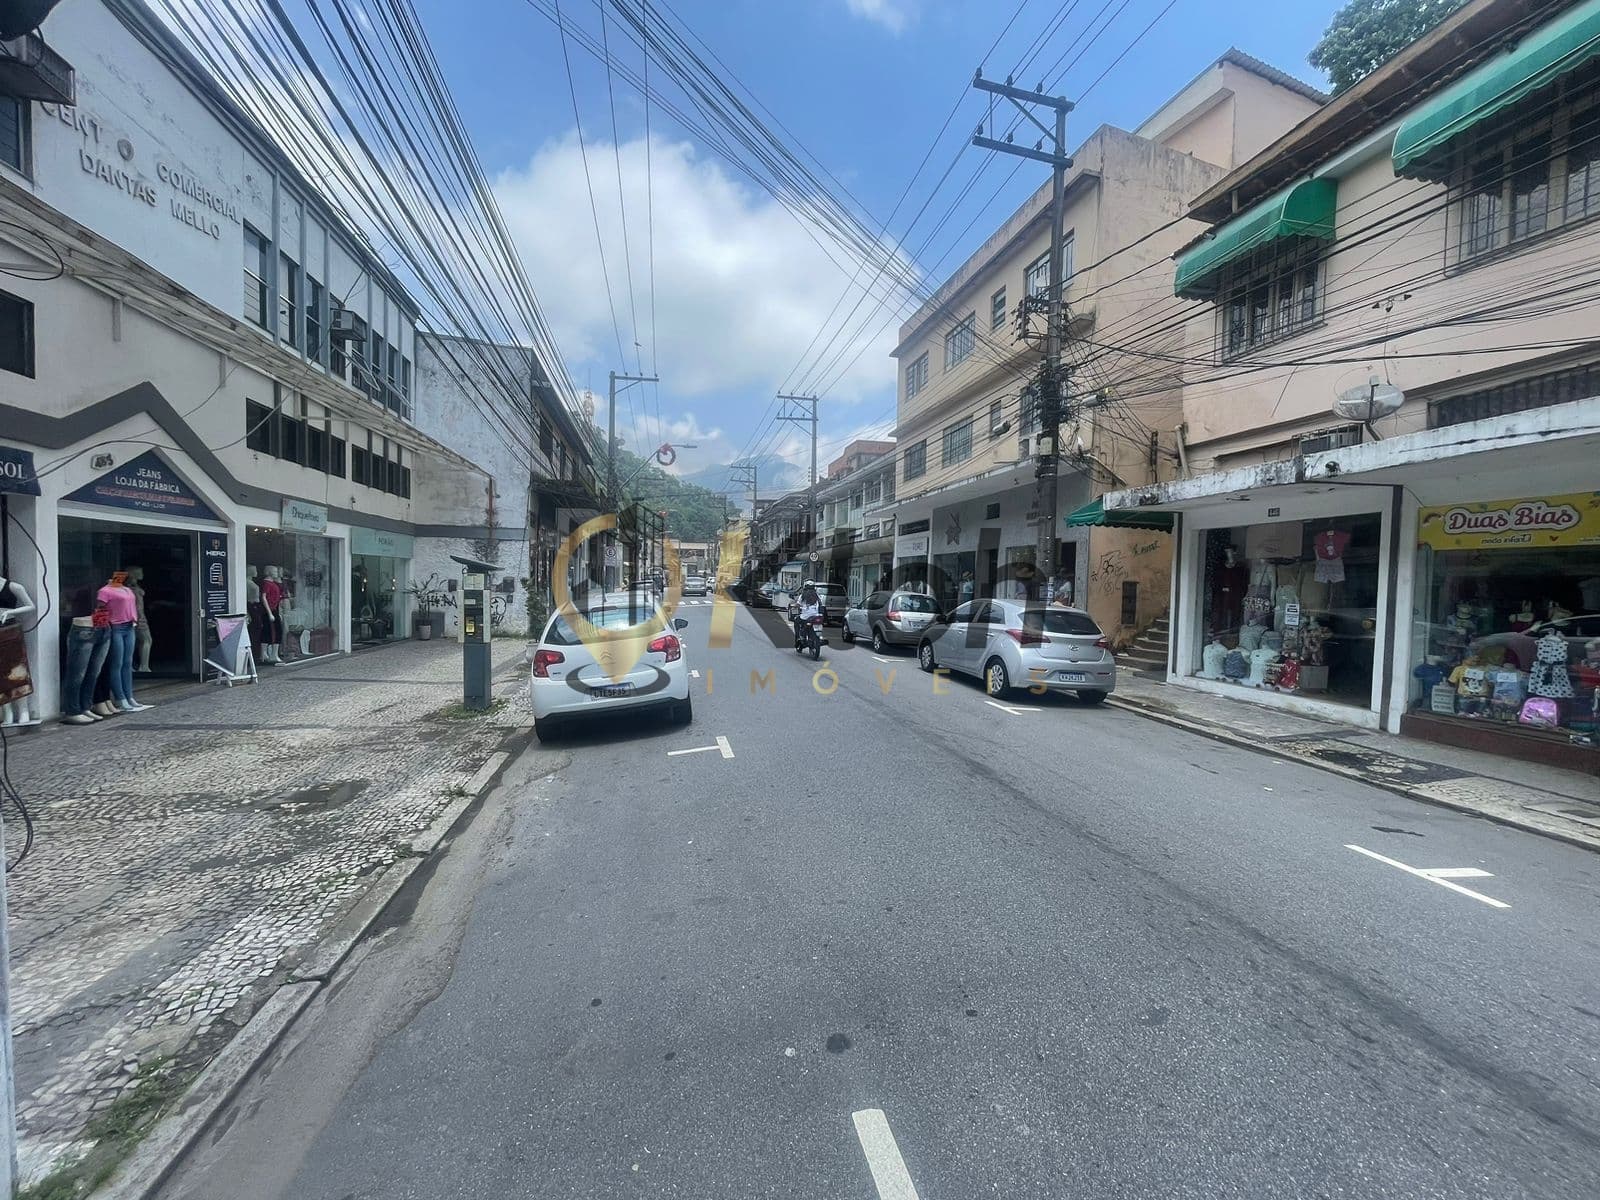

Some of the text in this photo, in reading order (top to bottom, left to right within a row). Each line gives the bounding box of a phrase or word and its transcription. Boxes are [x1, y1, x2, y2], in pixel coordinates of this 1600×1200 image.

[79, 149, 220, 241] DANTAS MELLO
[157, 161, 240, 225] COMERCIAL
[115, 476, 138, 487] LOJA
[138, 480, 149, 489] DA
[137, 468, 162, 480] JEANS
[1449, 506, 1574, 530] Duas Bias
